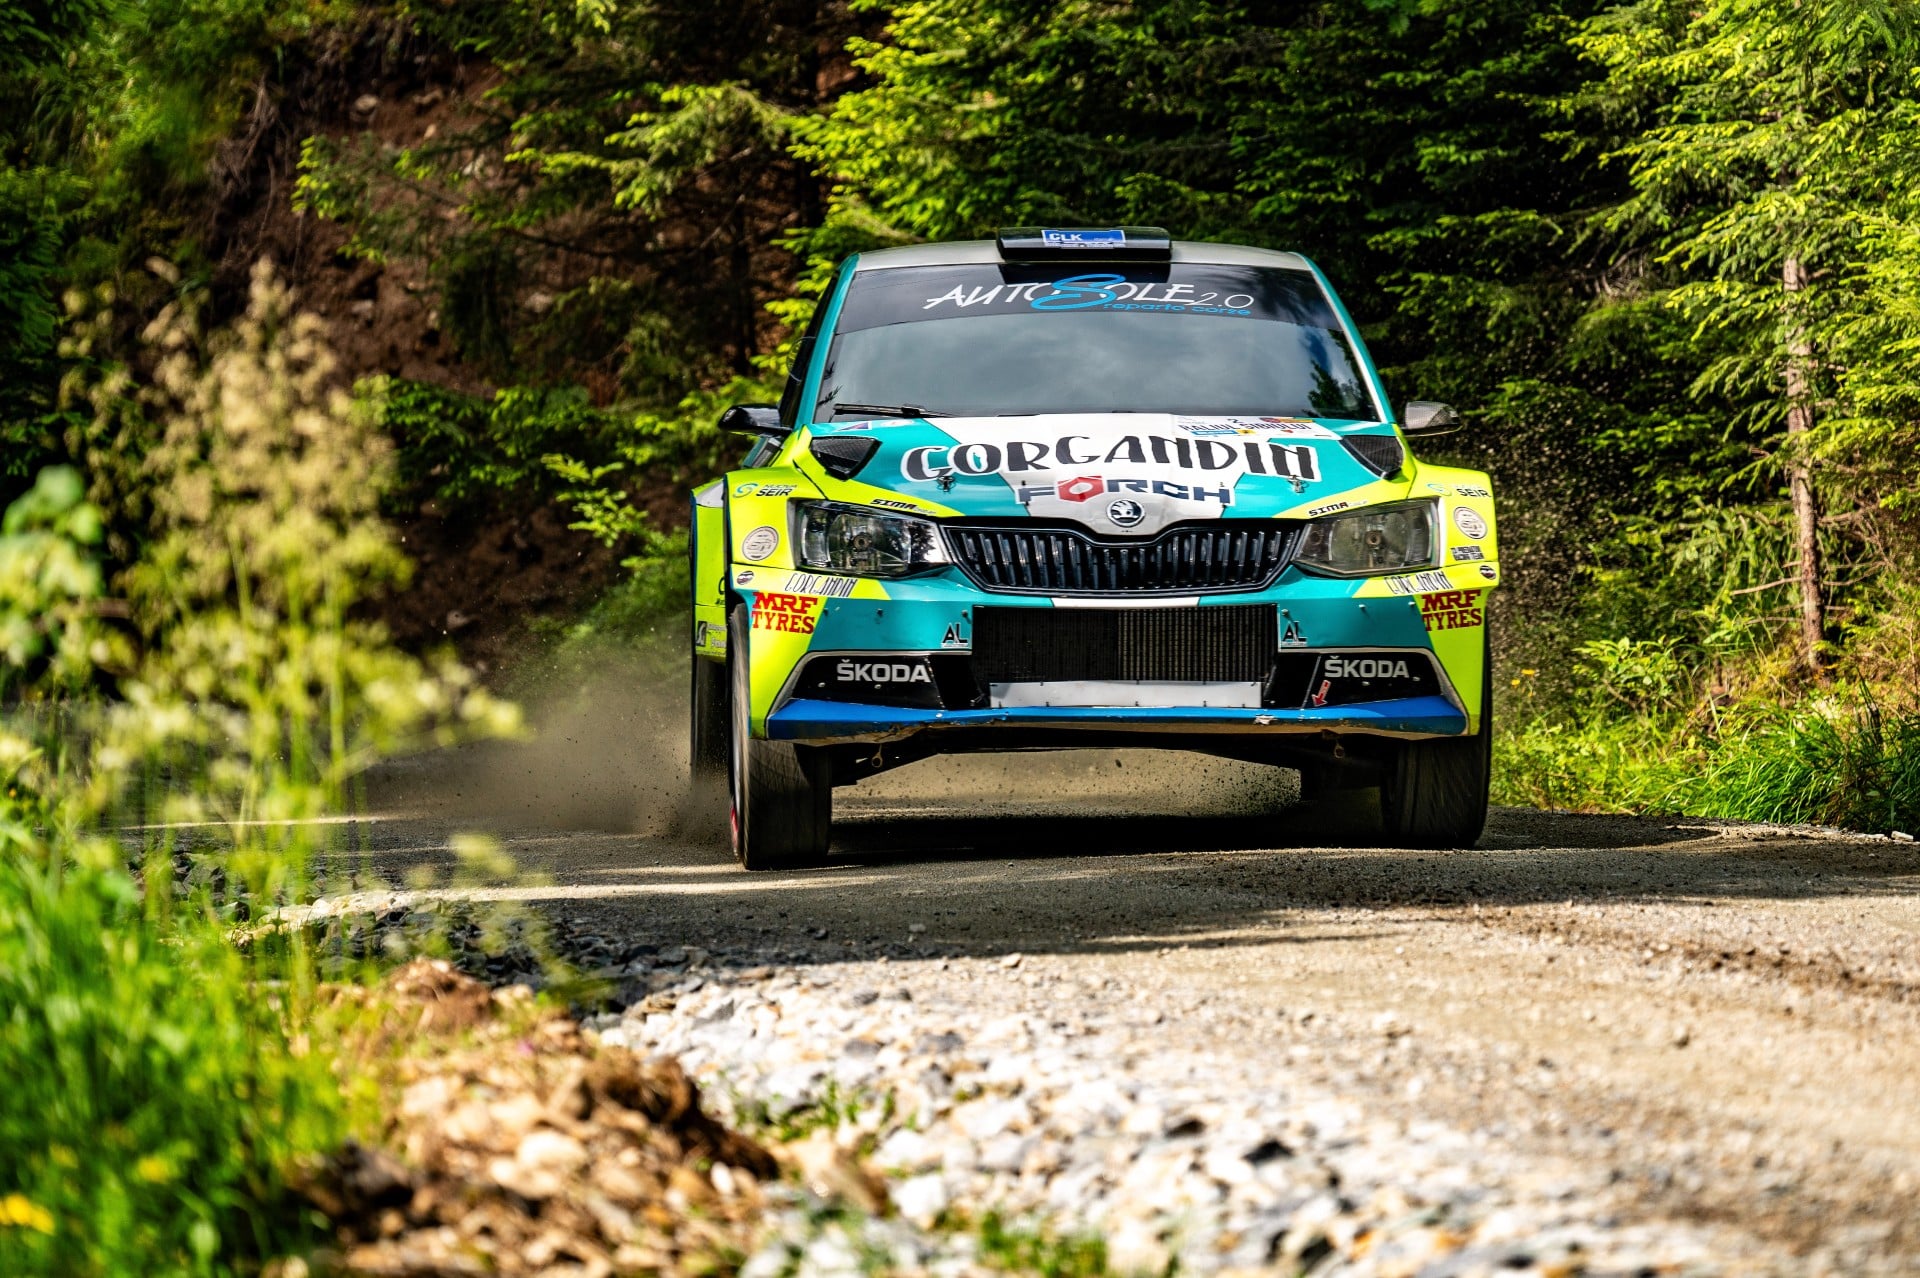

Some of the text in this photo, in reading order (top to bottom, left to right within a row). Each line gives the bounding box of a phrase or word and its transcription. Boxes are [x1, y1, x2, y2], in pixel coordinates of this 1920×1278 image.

[756, 488, 793, 497] SEIR
[1456, 488, 1493, 498] SEIR
[870, 498, 918, 510] SIMA
[1308, 501, 1349, 517] SIMA
[751, 591, 818, 614] MRF
[1421, 590, 1482, 612] MRF
[751, 610, 815, 635] TYRES
[1421, 608, 1483, 632] TYRES
[836, 658, 932, 683] ŠKODA
[1324, 655, 1410, 679] ŠKODA
